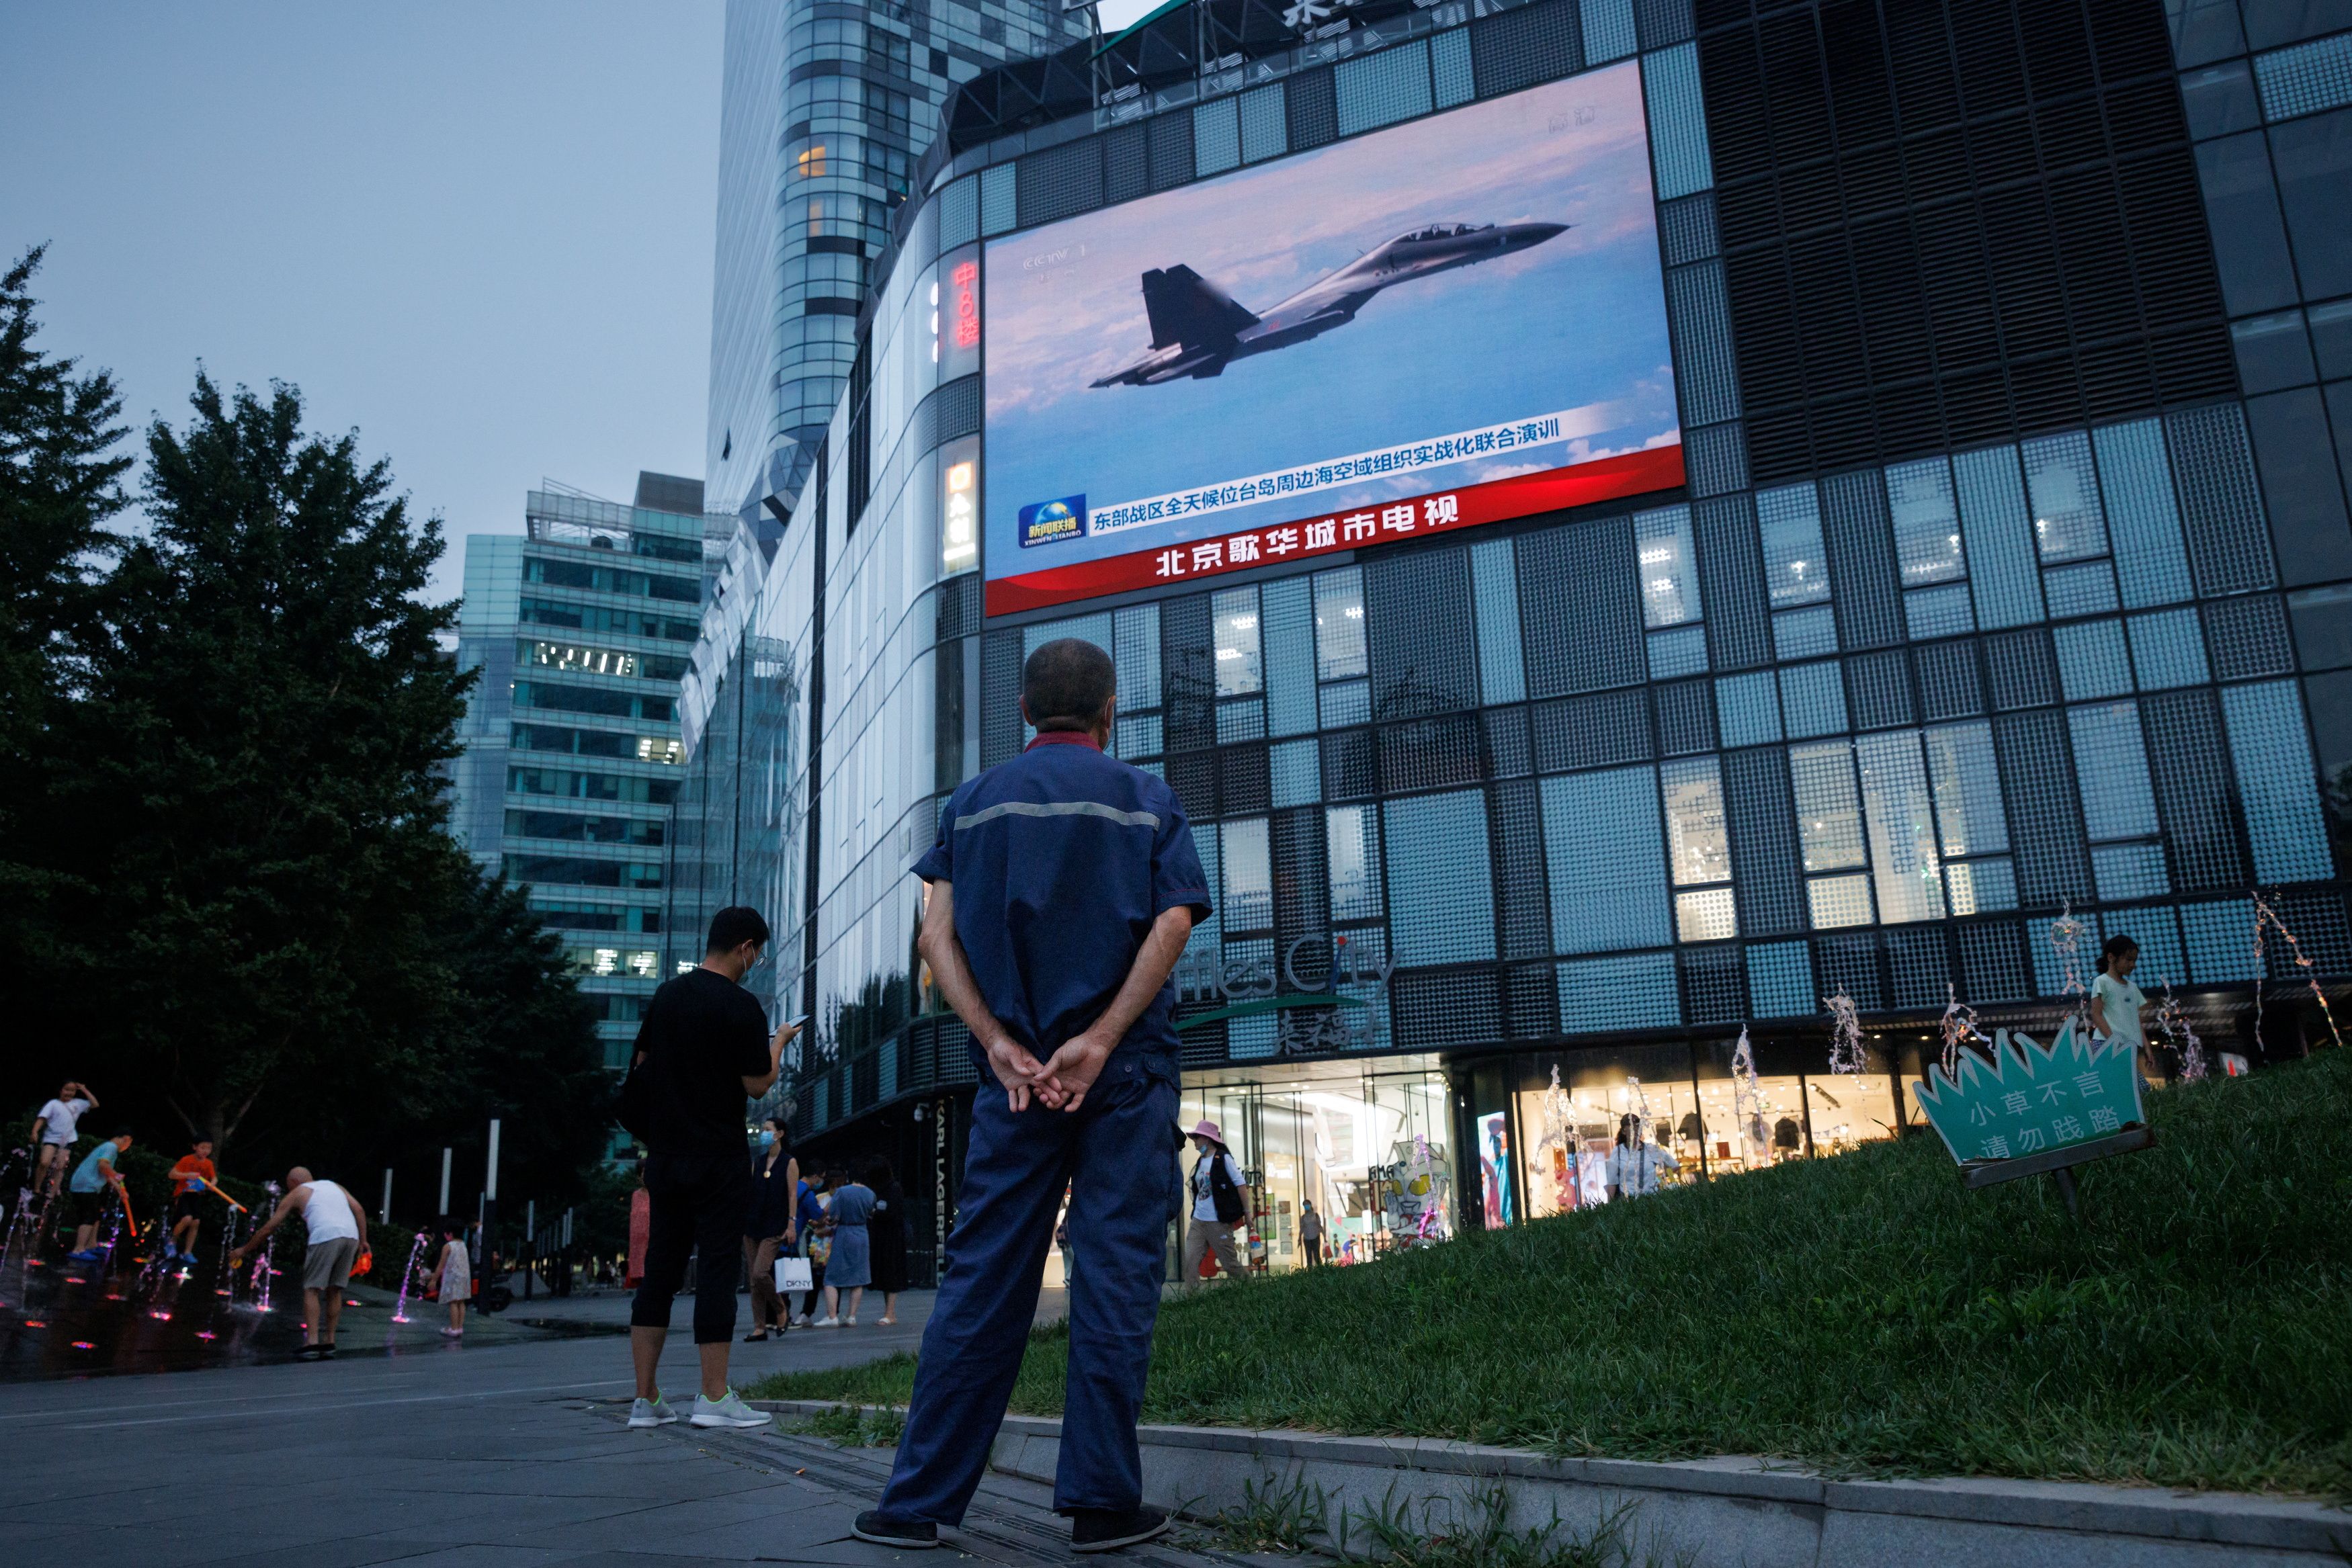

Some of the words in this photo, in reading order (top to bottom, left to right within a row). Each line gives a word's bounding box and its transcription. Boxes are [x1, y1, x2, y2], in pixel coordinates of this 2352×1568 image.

[1023, 247, 1069, 270] CCTV
[1094, 417, 1560, 531] 东部战区全天候位台岛周边海空域组织实战化联合演训
[1024, 535, 1052, 546] XINWEN
[1055, 529, 1082, 540] LIANBO
[1028, 517, 1077, 538] 新闻联播
[1156, 494, 1458, 576] 北京歌华城市电视
[1173, 948, 1277, 1002] ffles
[1284, 933, 1402, 998] City
[936, 1098, 946, 1156] KARL
[1970, 1070, 2105, 1127] 小草不言
[1980, 1105, 2122, 1160] 请勿践踏
